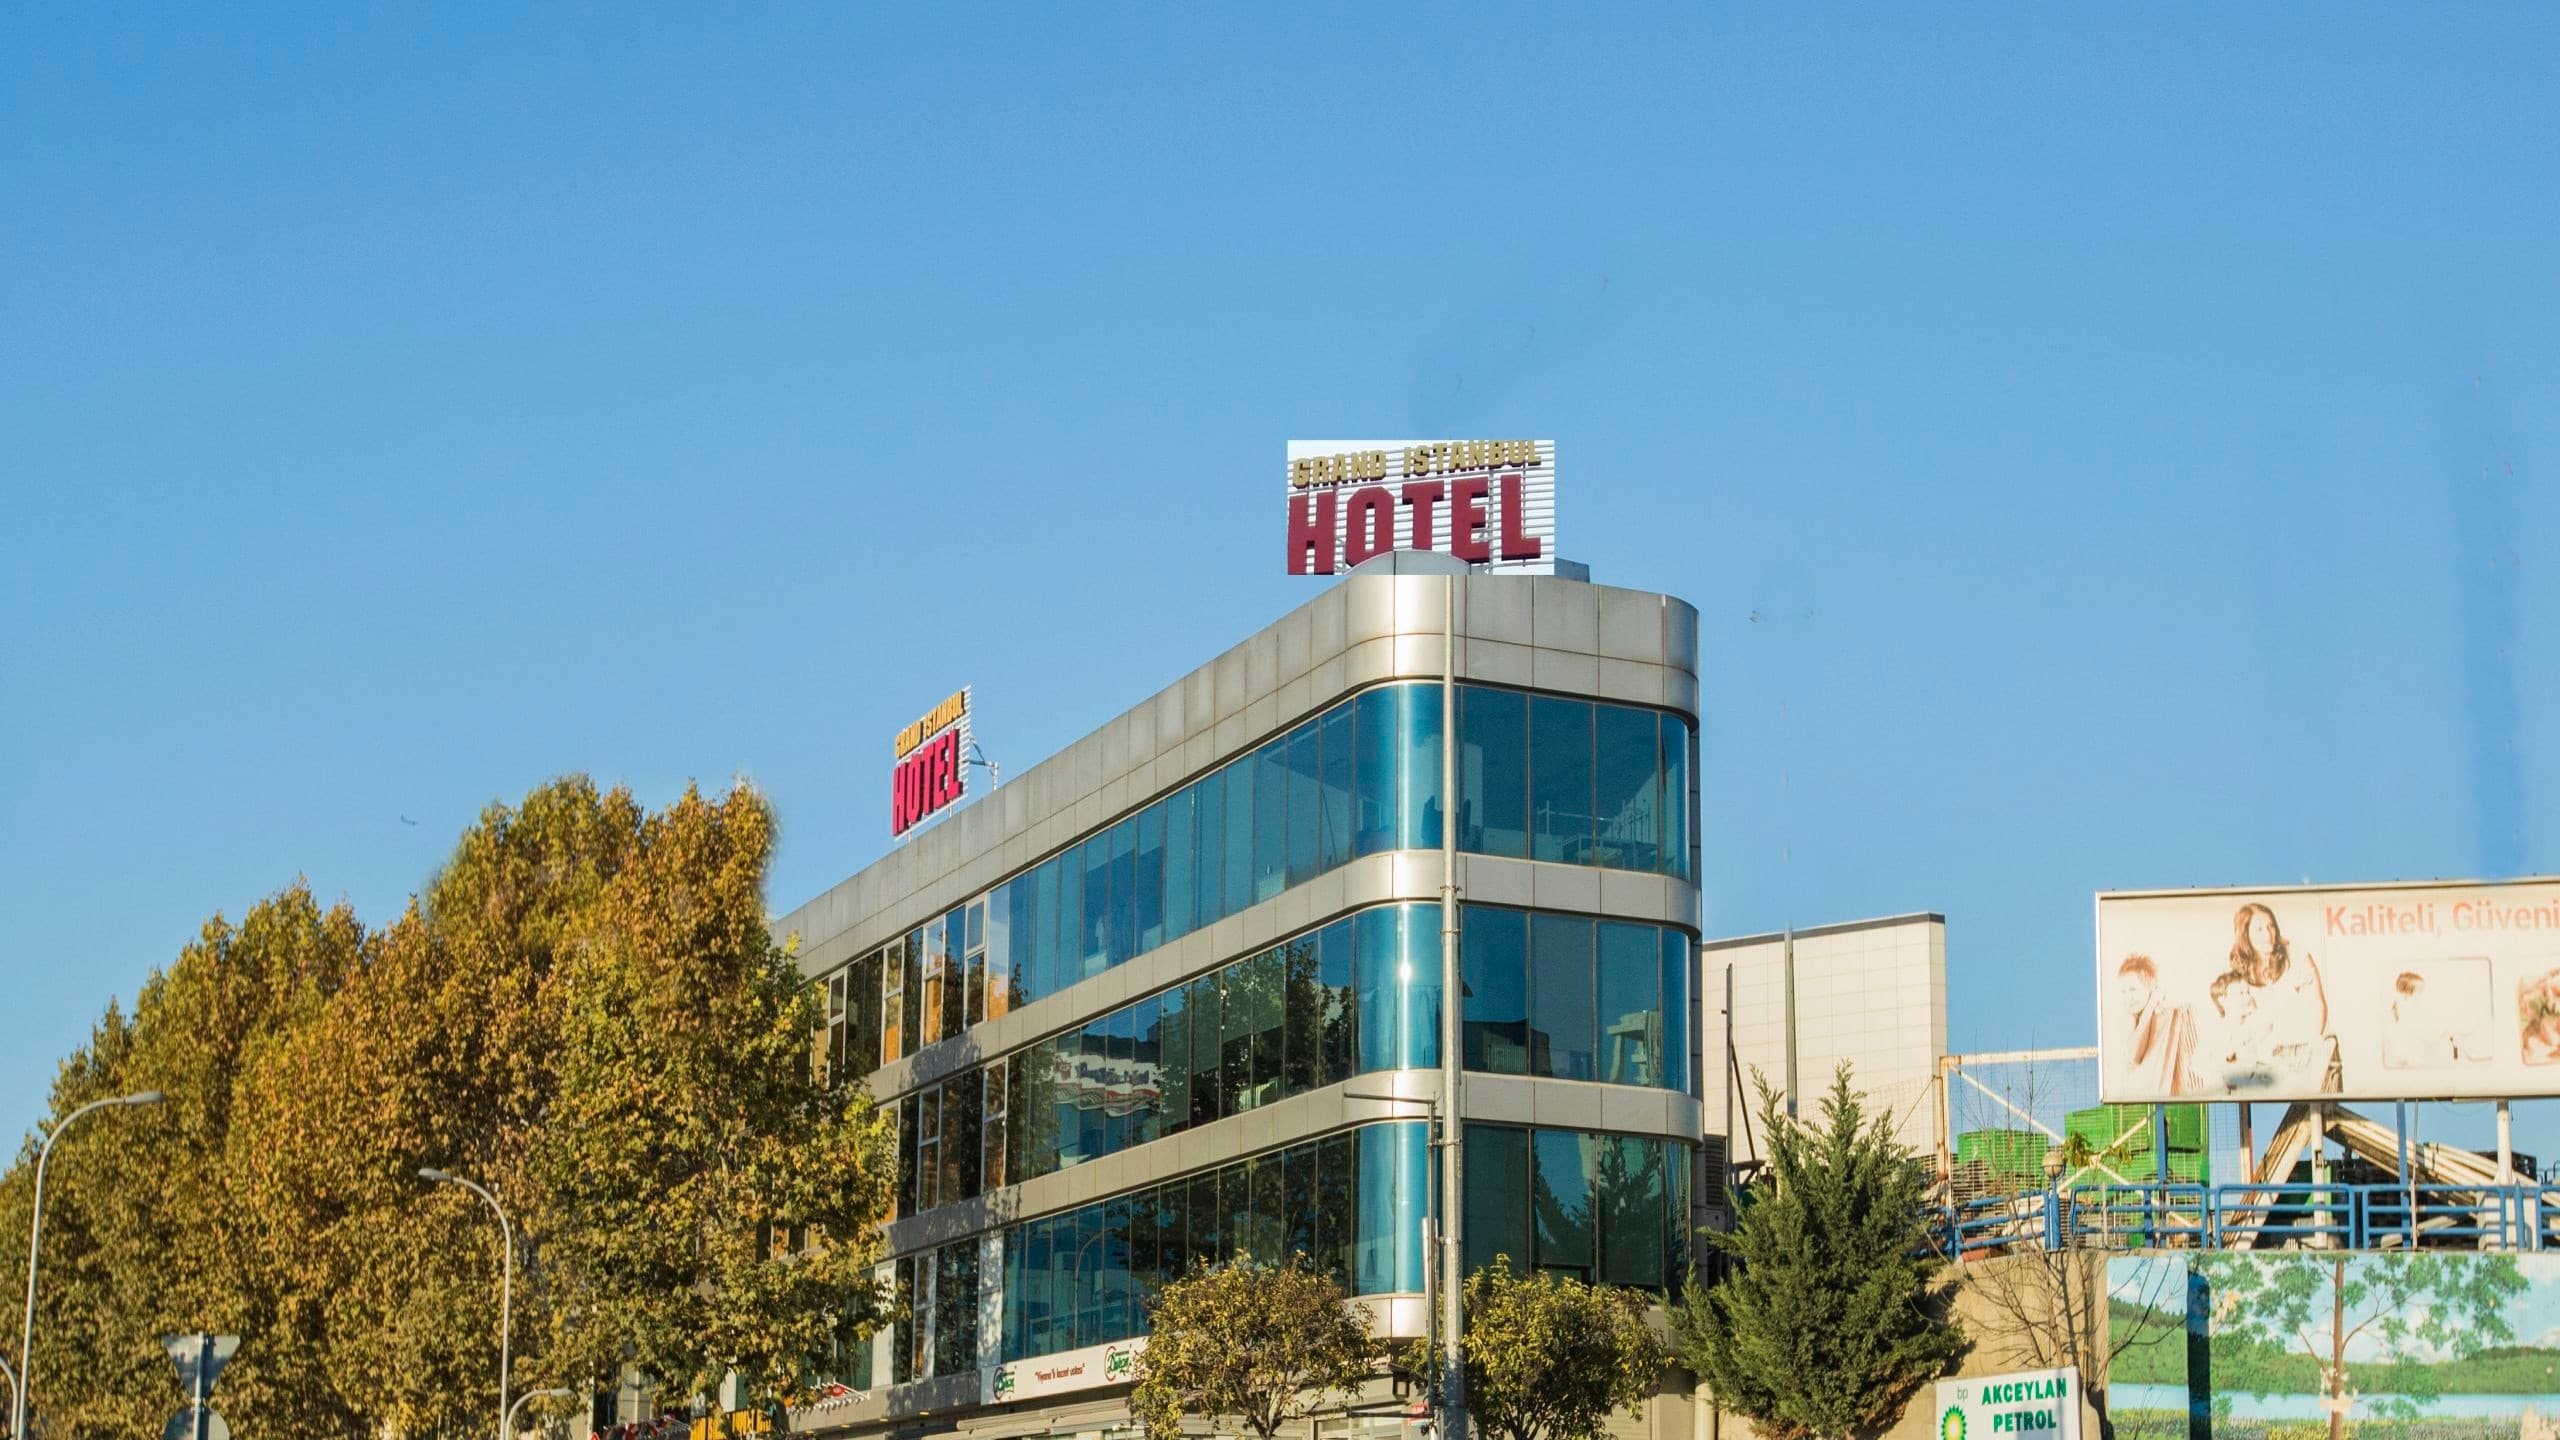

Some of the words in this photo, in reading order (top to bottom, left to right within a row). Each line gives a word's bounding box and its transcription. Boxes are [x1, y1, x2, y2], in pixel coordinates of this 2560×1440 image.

[1292, 450, 1387, 488] GRAND
[1287, 473, 1541, 574] HOTEL
[893, 729, 963, 836] HOTEL
[1957, 1386, 1968, 1401] bp
[1981, 1378, 2067, 1405] AKCEYLAN
[1993, 1409, 2057, 1433] PETROL
